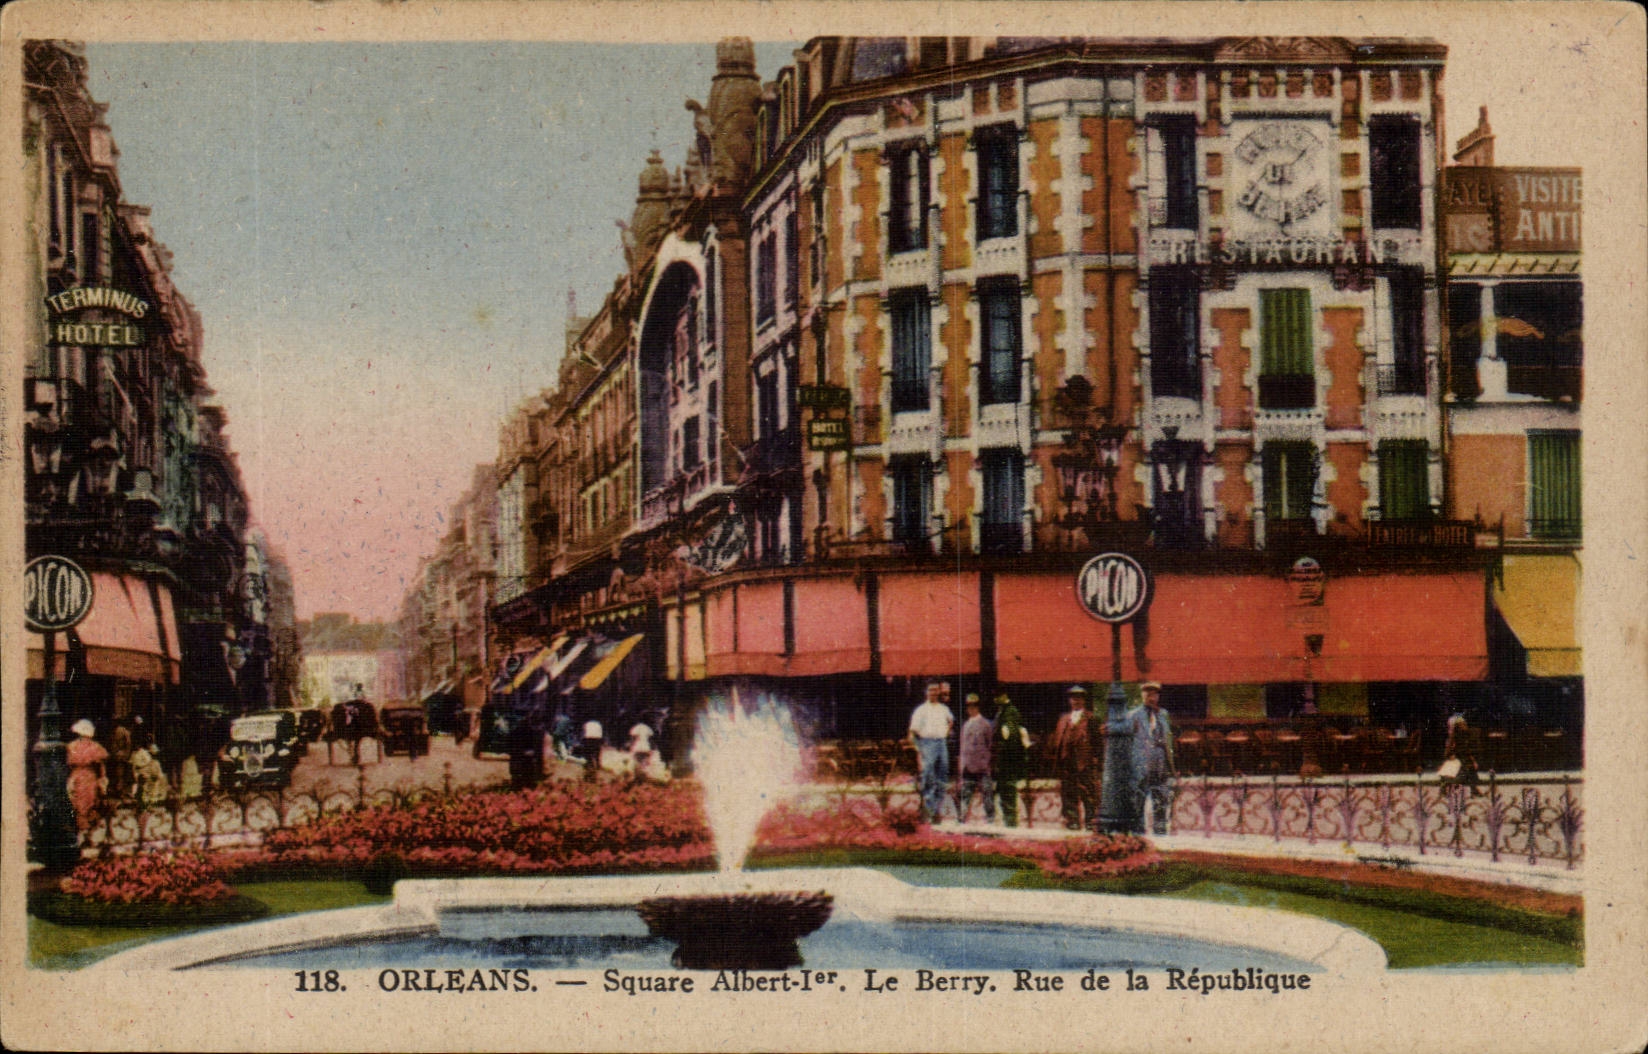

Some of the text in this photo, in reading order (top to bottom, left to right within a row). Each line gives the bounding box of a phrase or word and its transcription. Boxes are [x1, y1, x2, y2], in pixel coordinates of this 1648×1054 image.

[1513, 208, 1579, 241] ANTI
[48, 287, 149, 319] TERMINUS
[57, 323, 137, 346] HOTEL
[24, 562, 82, 622] PICON
[1085, 559, 1138, 616] PICON
